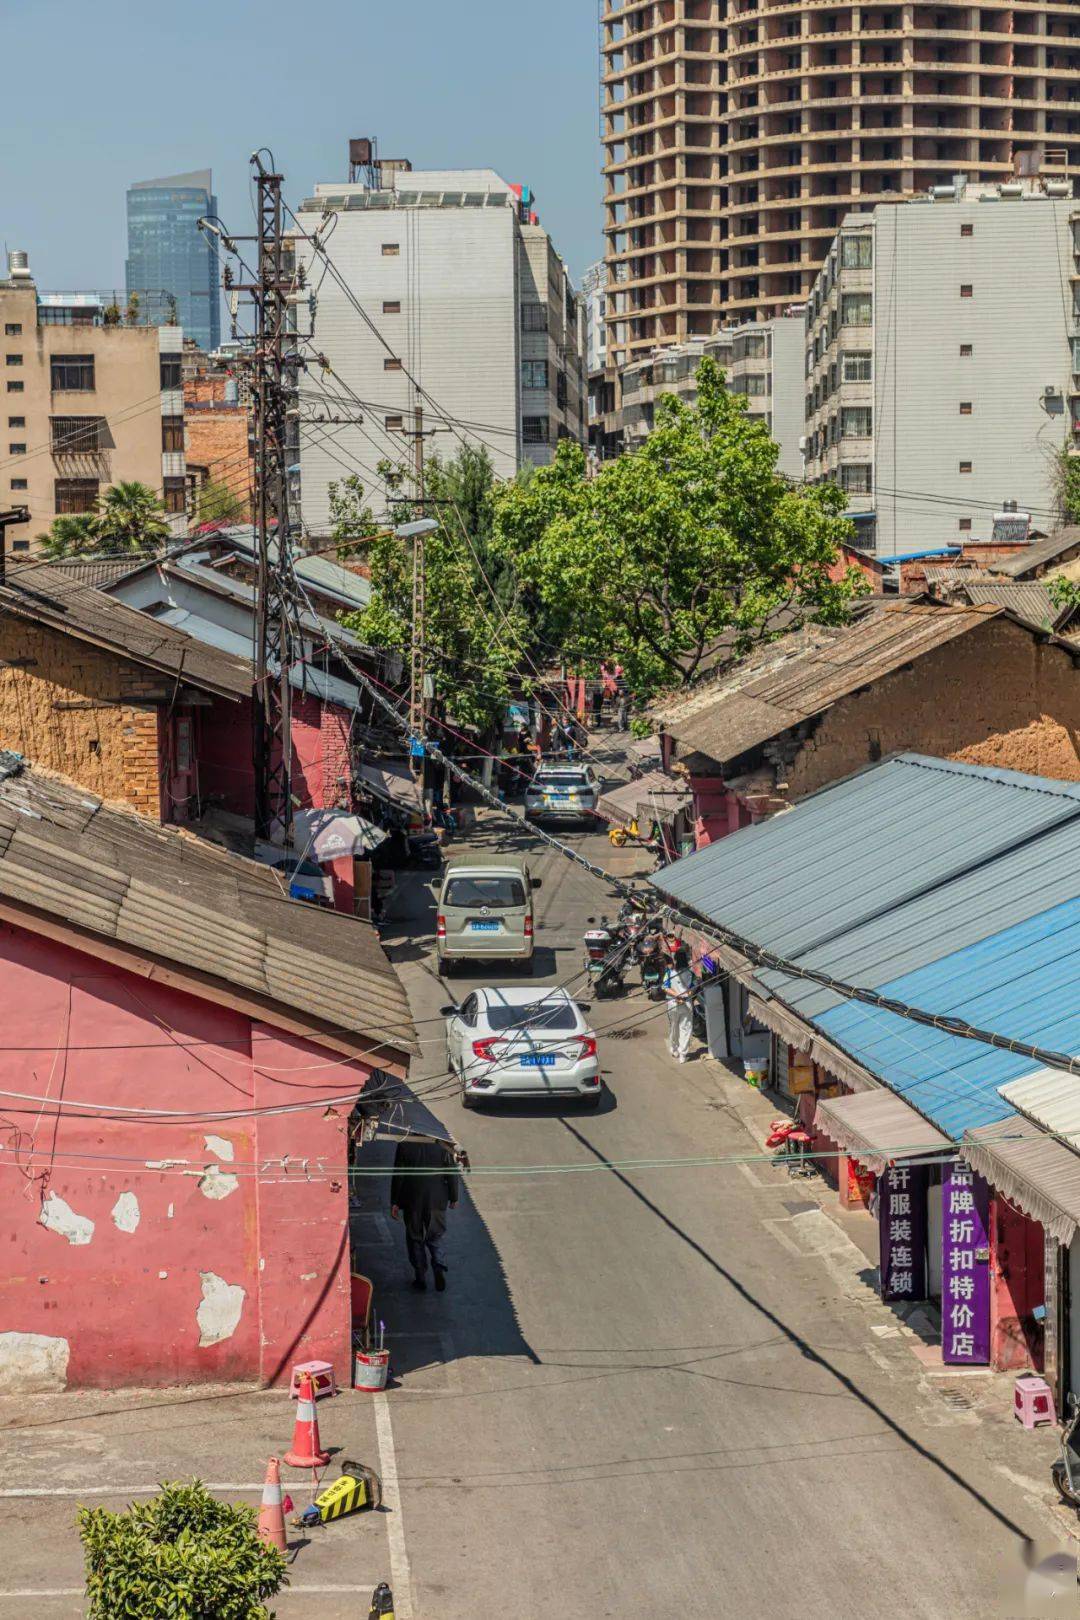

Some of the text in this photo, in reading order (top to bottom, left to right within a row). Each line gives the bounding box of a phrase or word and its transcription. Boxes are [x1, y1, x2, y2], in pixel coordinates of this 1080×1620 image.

[888, 1167, 913, 1293] 轩服装连锁
[949, 1162, 975, 1356] 品牌折扣特价店
